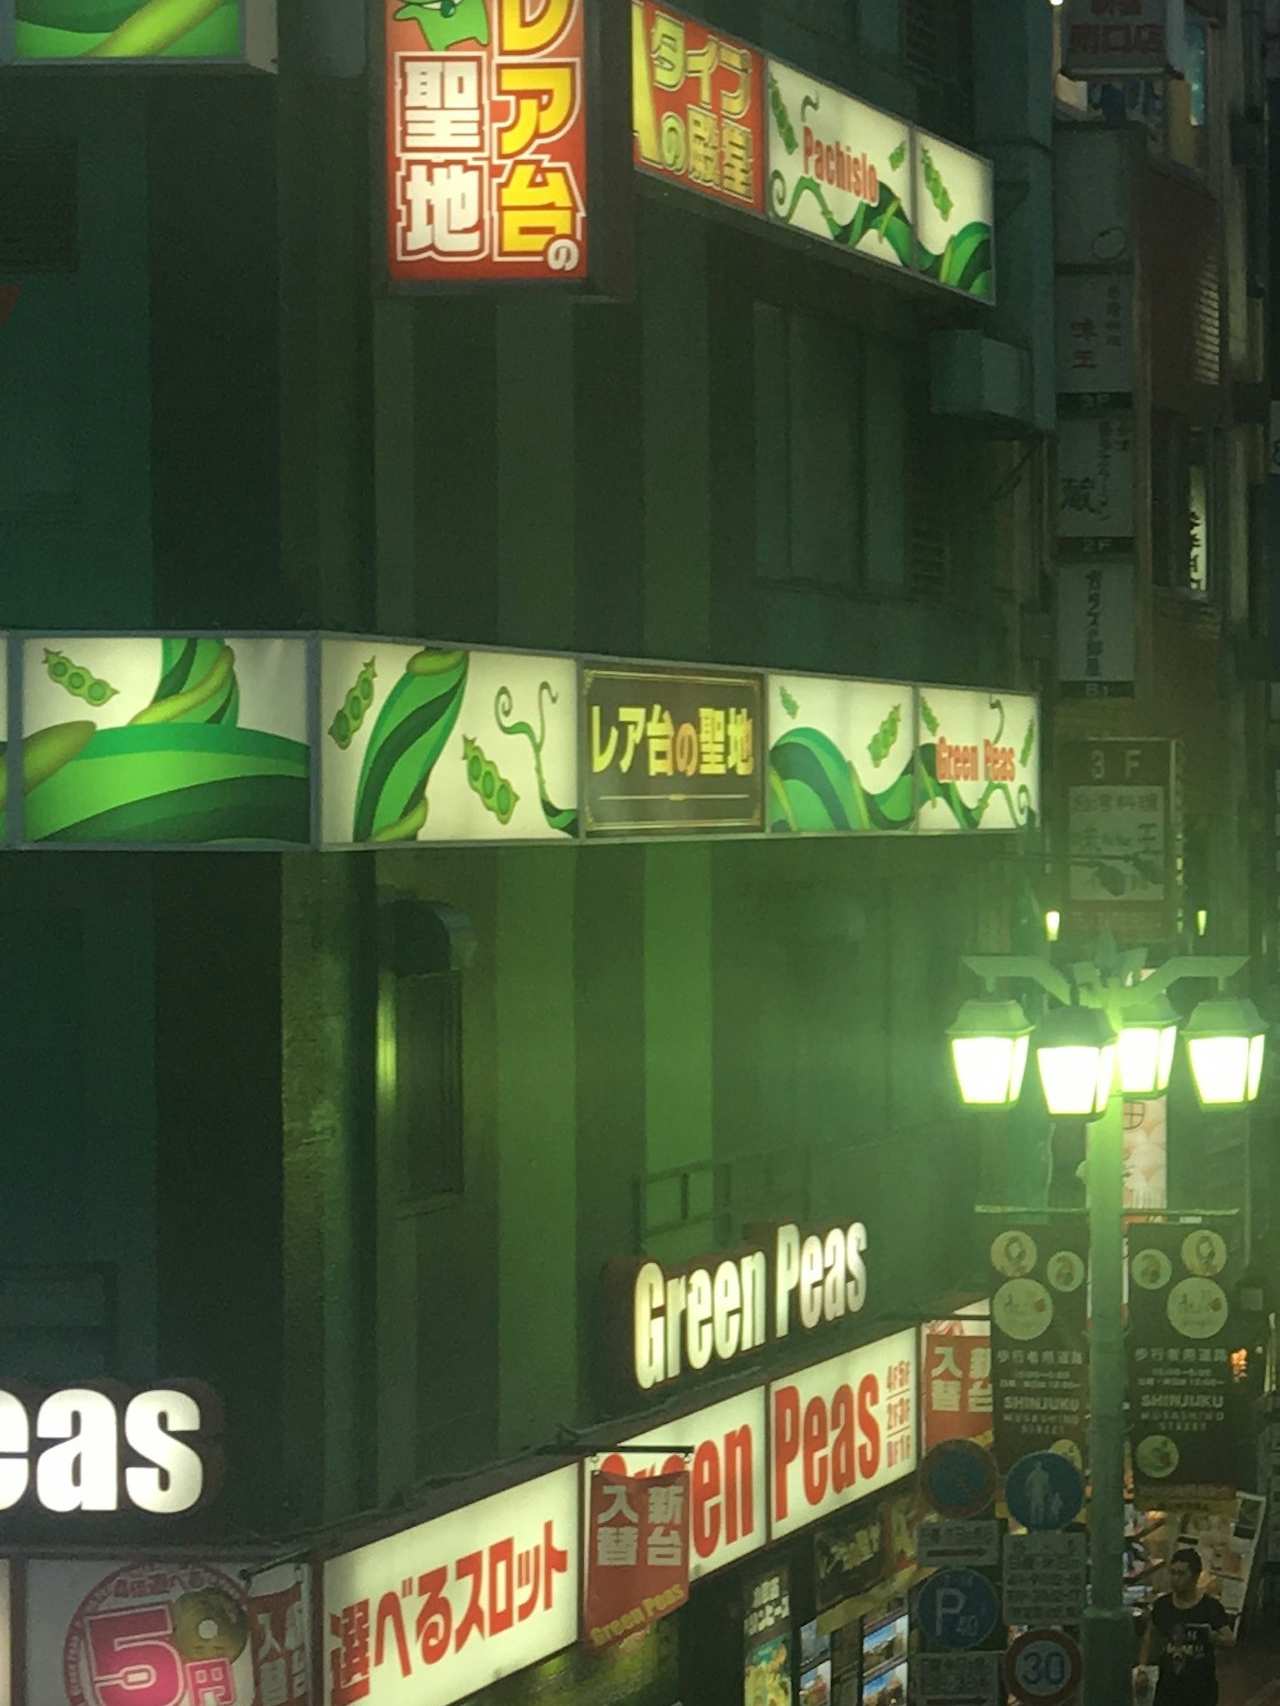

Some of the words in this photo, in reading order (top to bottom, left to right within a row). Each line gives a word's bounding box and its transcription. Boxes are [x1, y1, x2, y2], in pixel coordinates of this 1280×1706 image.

[400, 53, 488, 265] 聖地
[593, 701, 754, 778] レア台の聖地
[936, 735, 979, 783] Green
[980, 739, 1017, 782] Peas
[634, 1249, 766, 1390] Green
[776, 1220, 868, 1338] Peas
[1003, 1396, 1081, 1412] SHINJUKU
[1141, 1394, 1225, 1409] SHINJUKU
[774, 1372, 881, 1522] Peas
[935, 1586, 966, 1637] P
[1022, 1650, 1065, 1686] 30
